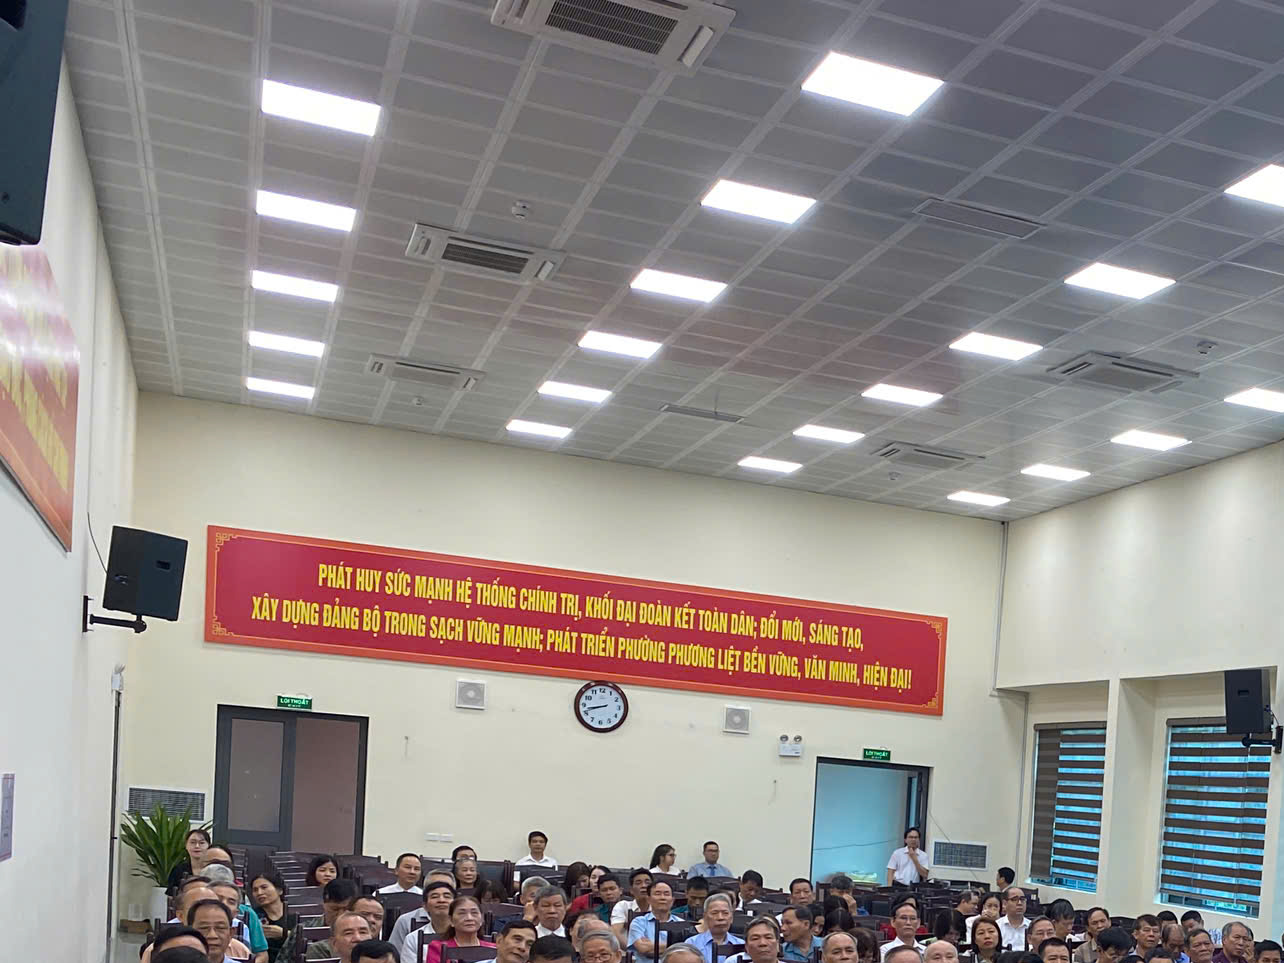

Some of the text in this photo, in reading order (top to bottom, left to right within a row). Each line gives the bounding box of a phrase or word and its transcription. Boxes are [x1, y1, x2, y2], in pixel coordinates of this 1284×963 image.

[252, 593, 912, 693] XÂY DỰNG ĐẢNG BỘ TRONG SẠCH VỮNG MẠNH; PHÁT TRIỂN PHƯỜNG PHƯƠNG LIỆT BỀN VỮNG, VĂN MINH, HIỆN ĐẠI!
[319, 562, 864, 652] PHÁT HUY SỨC MẠNH HỆ THỐNG CHÍNH TRỊ, KHỐI ĐẠI ĐOÀN KẾT TOÀN DÂN; ĐỔI MỚI, SÁNG TẠO,
